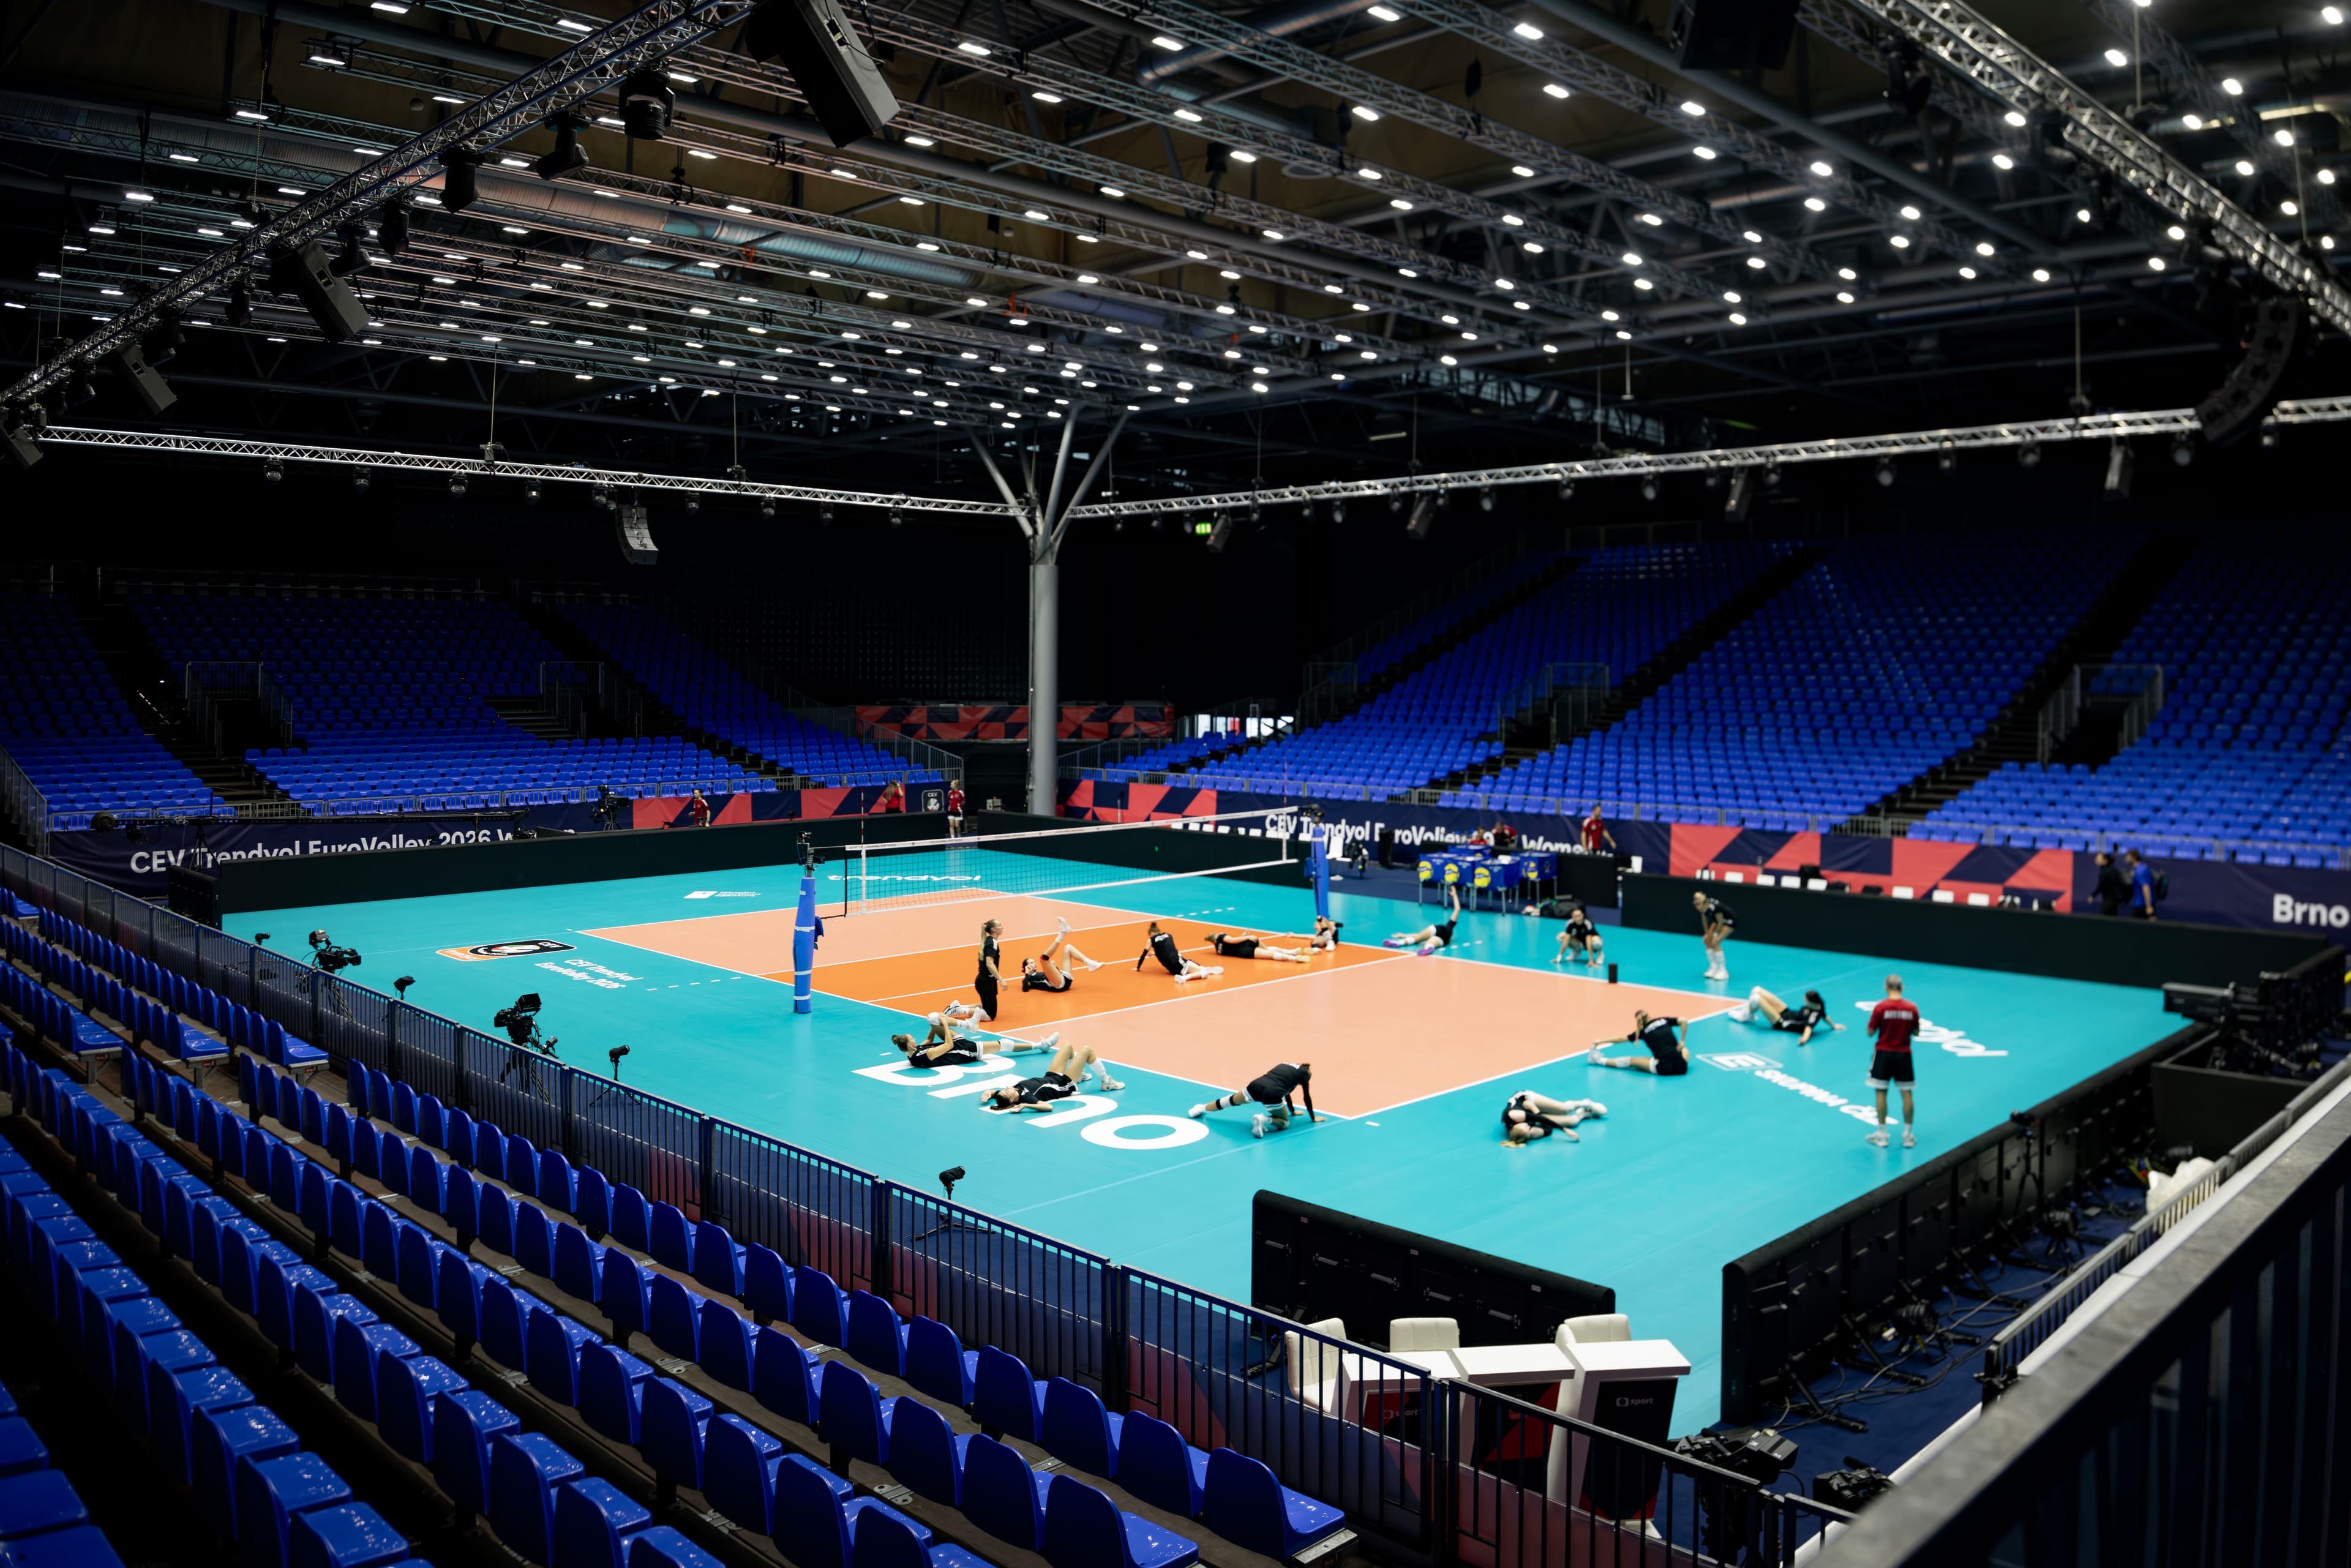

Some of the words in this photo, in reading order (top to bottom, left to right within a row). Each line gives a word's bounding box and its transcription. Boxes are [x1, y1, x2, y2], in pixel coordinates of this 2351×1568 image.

[1265, 814, 1297, 834] CEV
[1299, 816, 1371, 843] Trndyol
[1374, 822, 1468, 846] EroVolle
[130, 849, 186, 874] CEV
[2273, 893, 2350, 928] Brno
[850, 1053, 1210, 1150] Brno
[1630, 1397, 1654, 1406] sport
